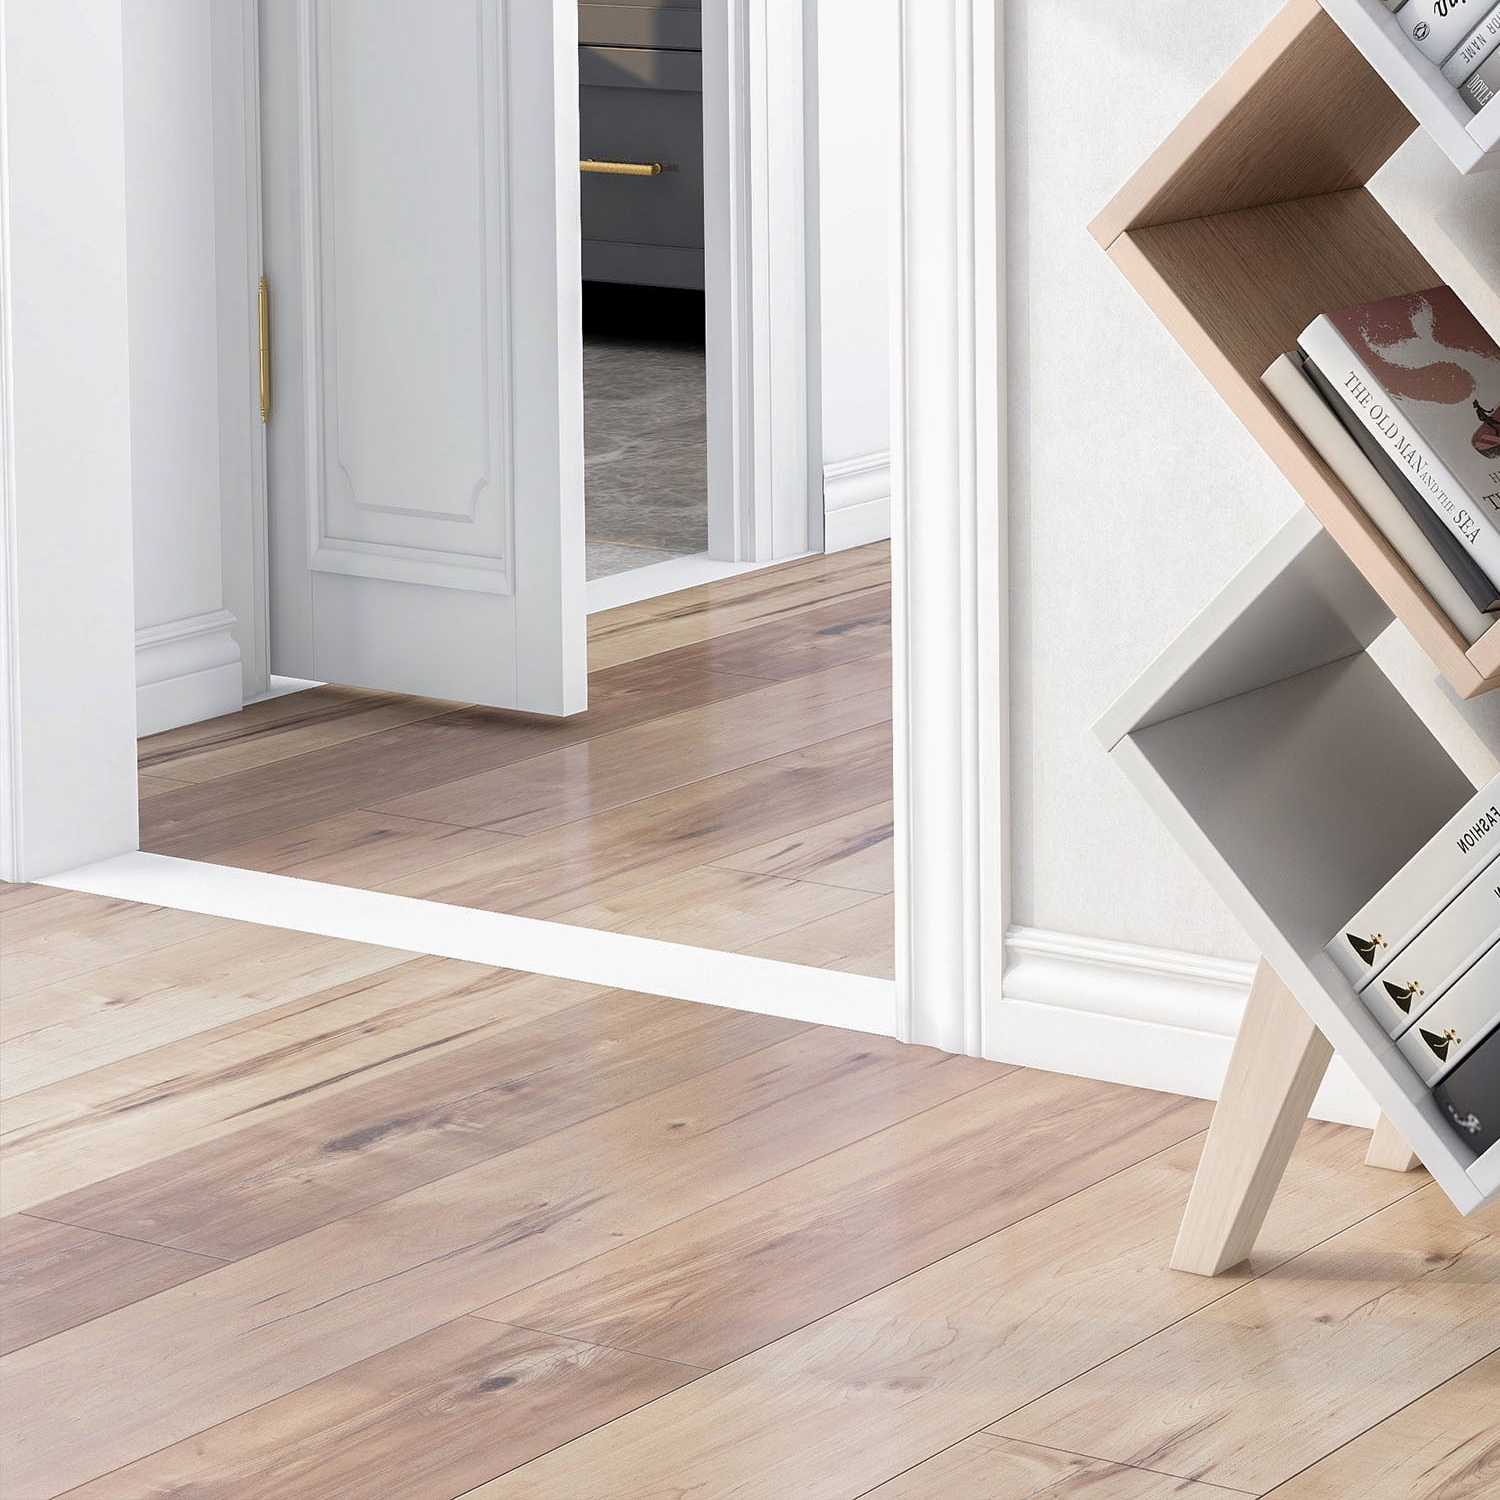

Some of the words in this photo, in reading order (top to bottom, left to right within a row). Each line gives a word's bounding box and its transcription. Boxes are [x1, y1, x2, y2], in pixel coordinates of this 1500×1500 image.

[1464, 33, 1487, 63] NAME
[1467, 74, 1494, 106] DOYLE
[1344, 371, 1373, 408] THE
[1369, 404, 1398, 440] OLD
[1394, 436, 1428, 474] MAN
[1419, 471, 1440, 494] AND
[1437, 490, 1456, 514] THE
[1453, 509, 1481, 545] SEA
